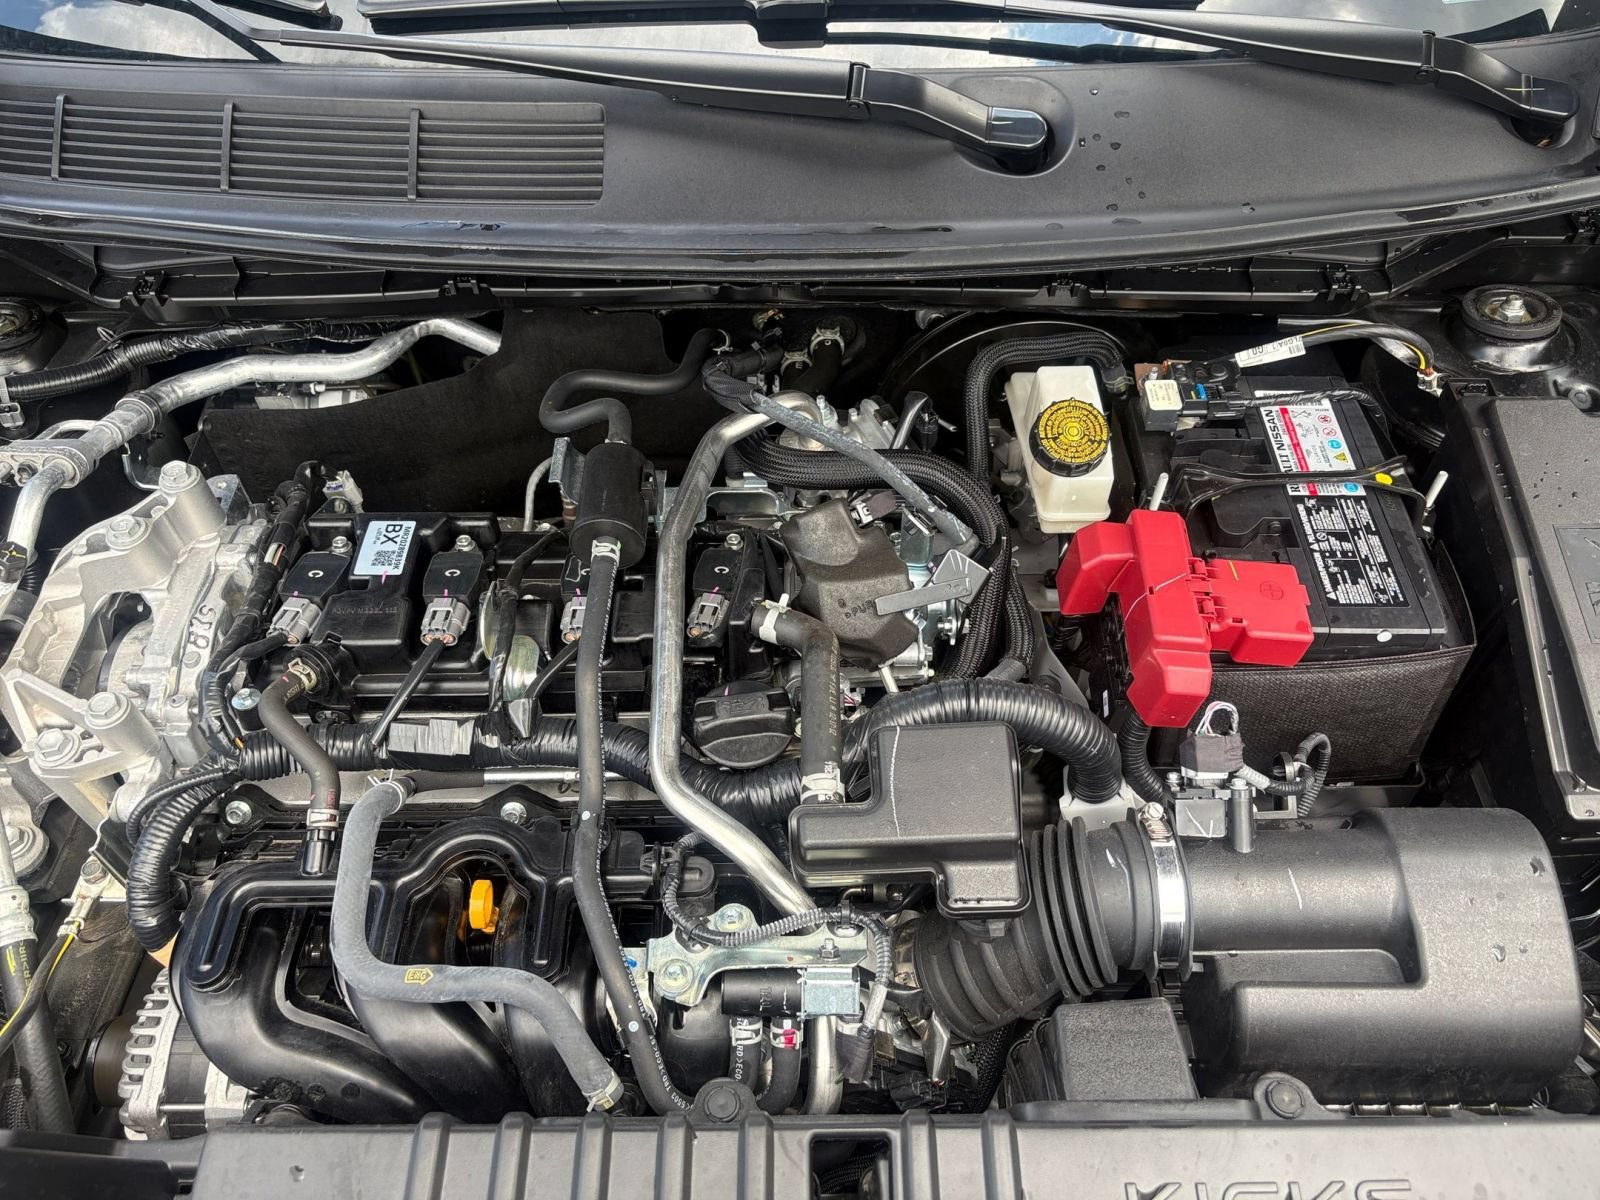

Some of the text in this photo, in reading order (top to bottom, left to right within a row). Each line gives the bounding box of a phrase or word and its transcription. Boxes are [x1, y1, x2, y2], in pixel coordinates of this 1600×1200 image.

[1264, 410, 1286, 451] NISSAN
[380, 524, 403, 545] BX
[407, 970, 426, 980] ENG
